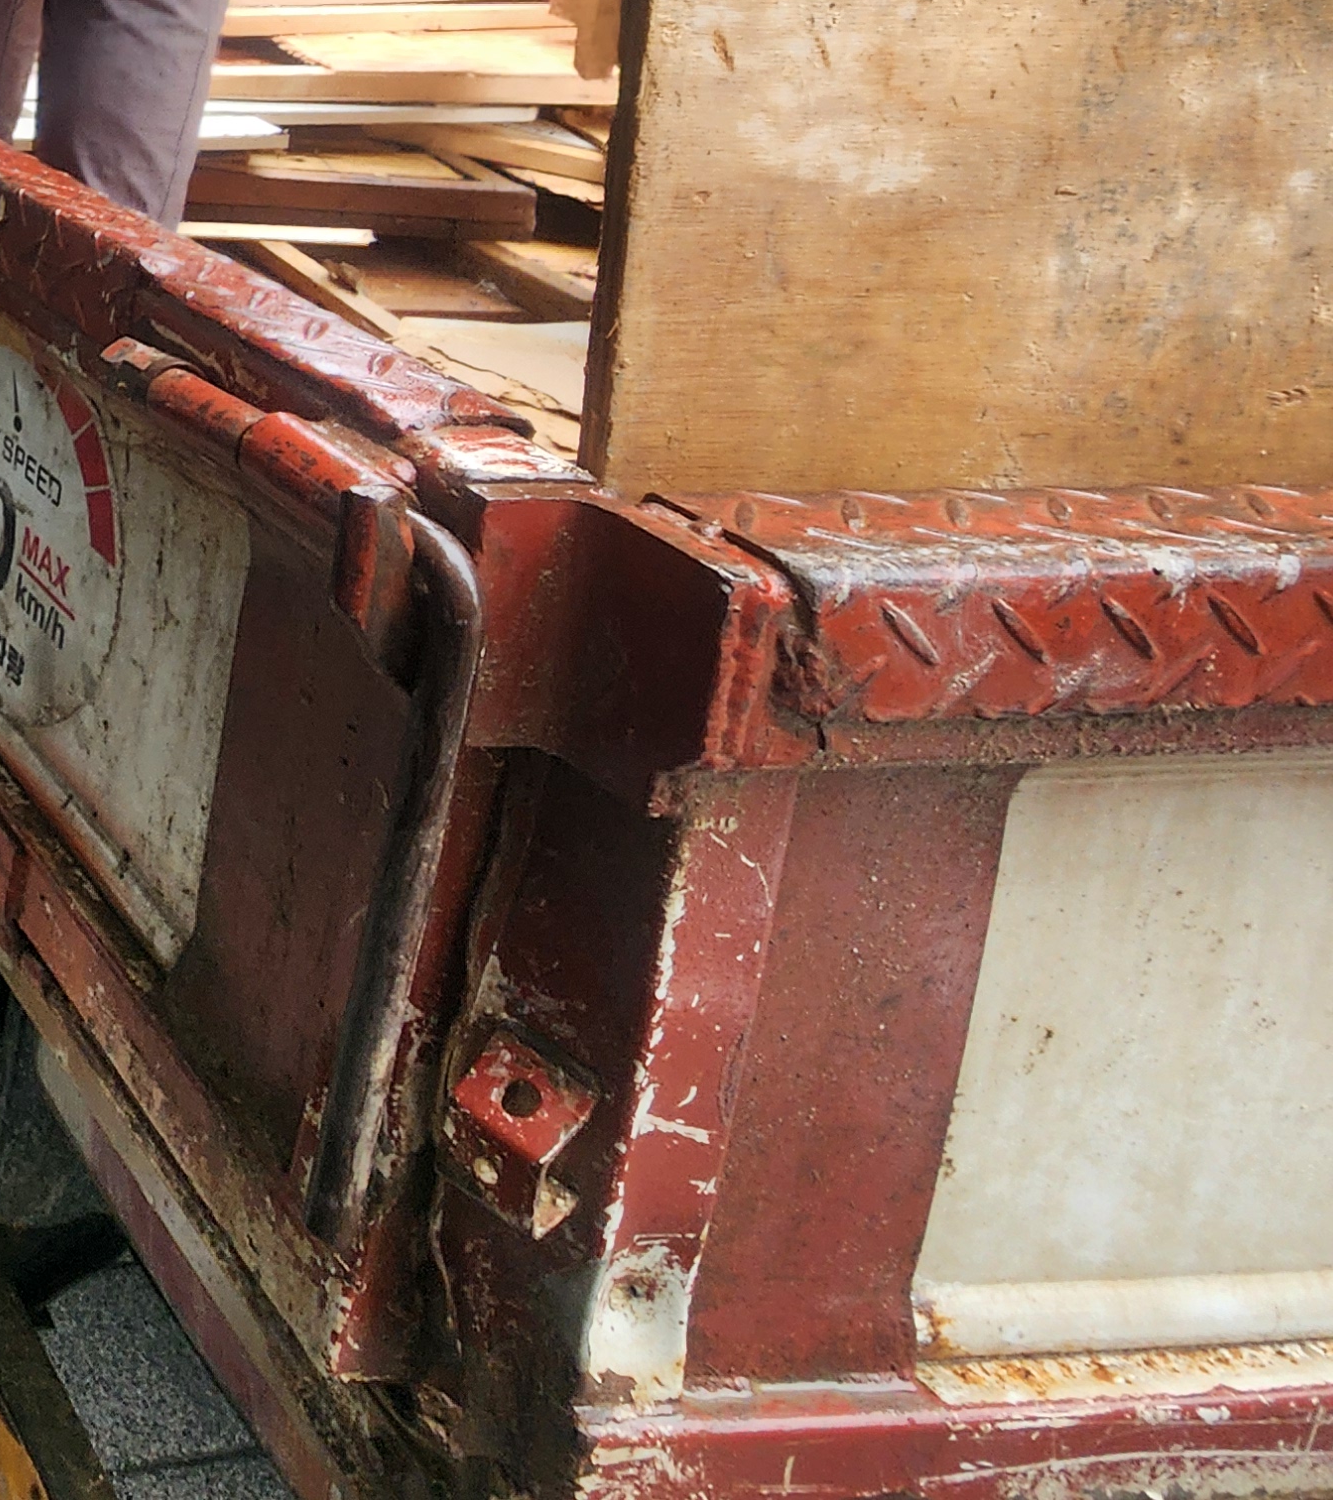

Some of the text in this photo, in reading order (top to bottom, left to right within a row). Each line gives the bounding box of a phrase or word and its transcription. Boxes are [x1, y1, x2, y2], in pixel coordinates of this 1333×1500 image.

[2, 434, 63, 508] SPEED
[21, 525, 71, 597] MAX
[14, 572, 66, 651] km/h
